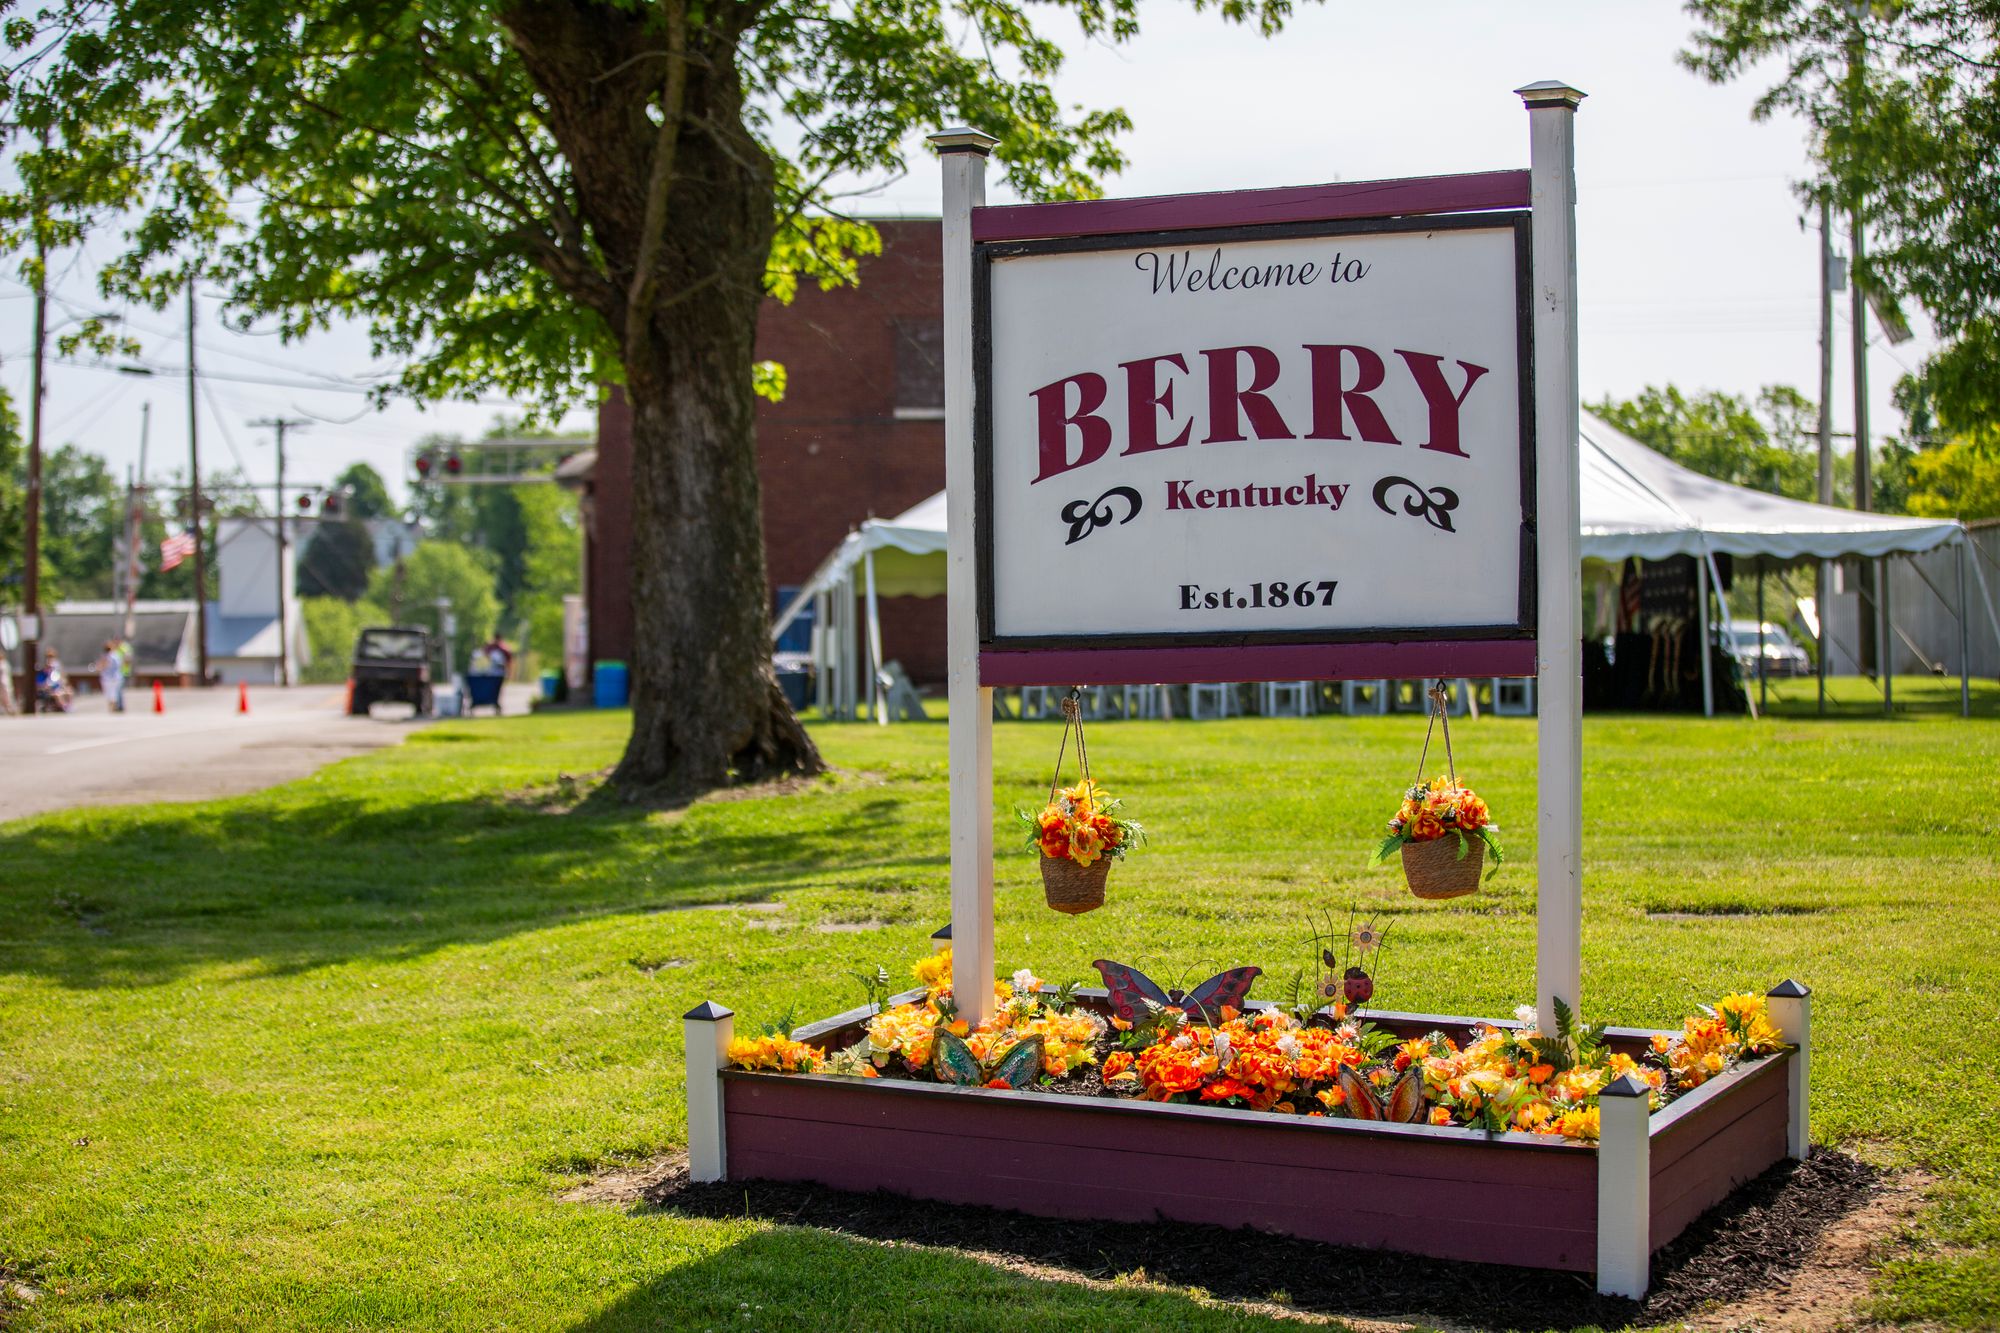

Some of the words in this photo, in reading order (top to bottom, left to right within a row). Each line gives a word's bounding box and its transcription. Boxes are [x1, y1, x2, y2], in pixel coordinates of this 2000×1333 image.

[1134, 247, 1322, 295] Welcome
[1330, 251, 1371, 282] to
[1029, 343, 1490, 485] BERRY
[1165, 474, 1351, 512] Kentucky
[1178, 580, 1339, 610] Est.1867
